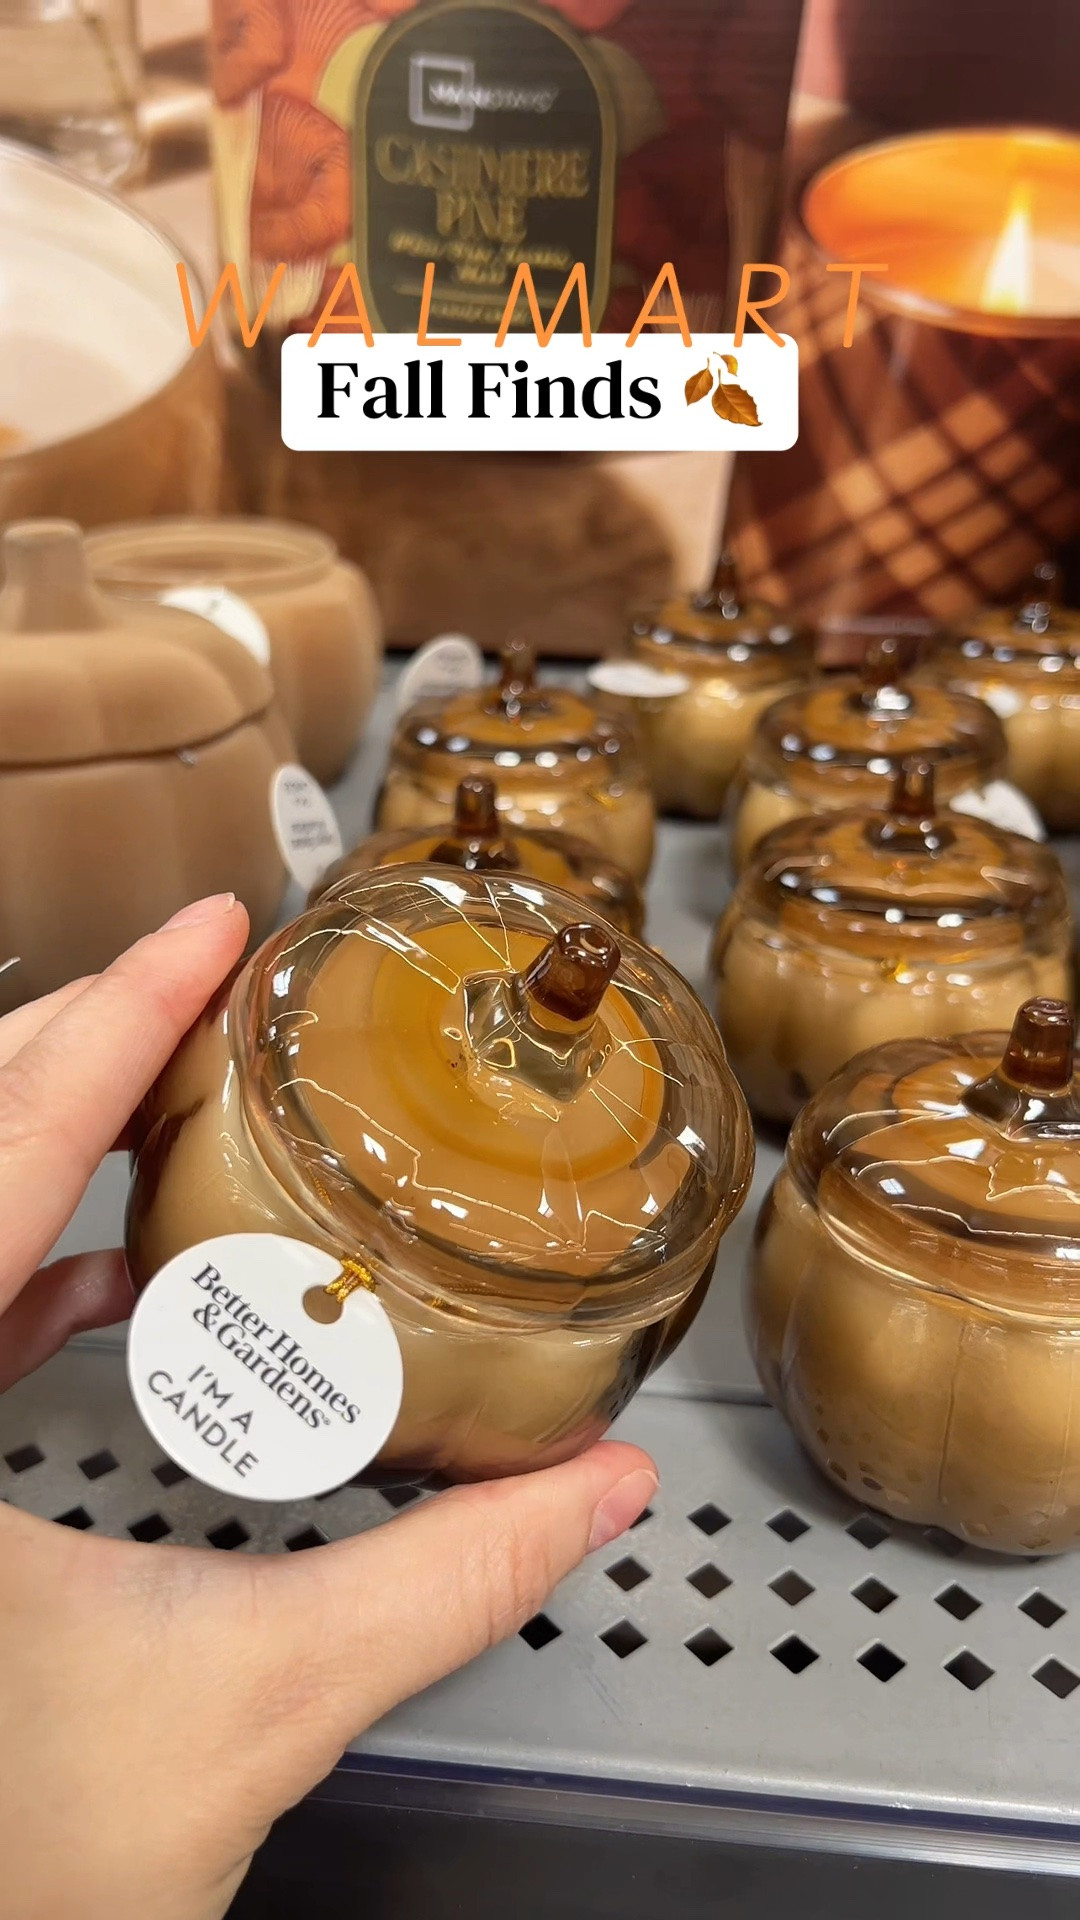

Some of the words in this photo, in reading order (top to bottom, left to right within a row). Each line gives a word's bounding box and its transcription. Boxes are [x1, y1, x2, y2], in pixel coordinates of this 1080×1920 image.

[191, 1262, 274, 1341] Better
[267, 1330, 361, 1424] Homes
[148, 1370, 259, 1478] CANDLE
[188, 1364, 234, 1409] I'M
[231, 1410, 254, 1434] A
